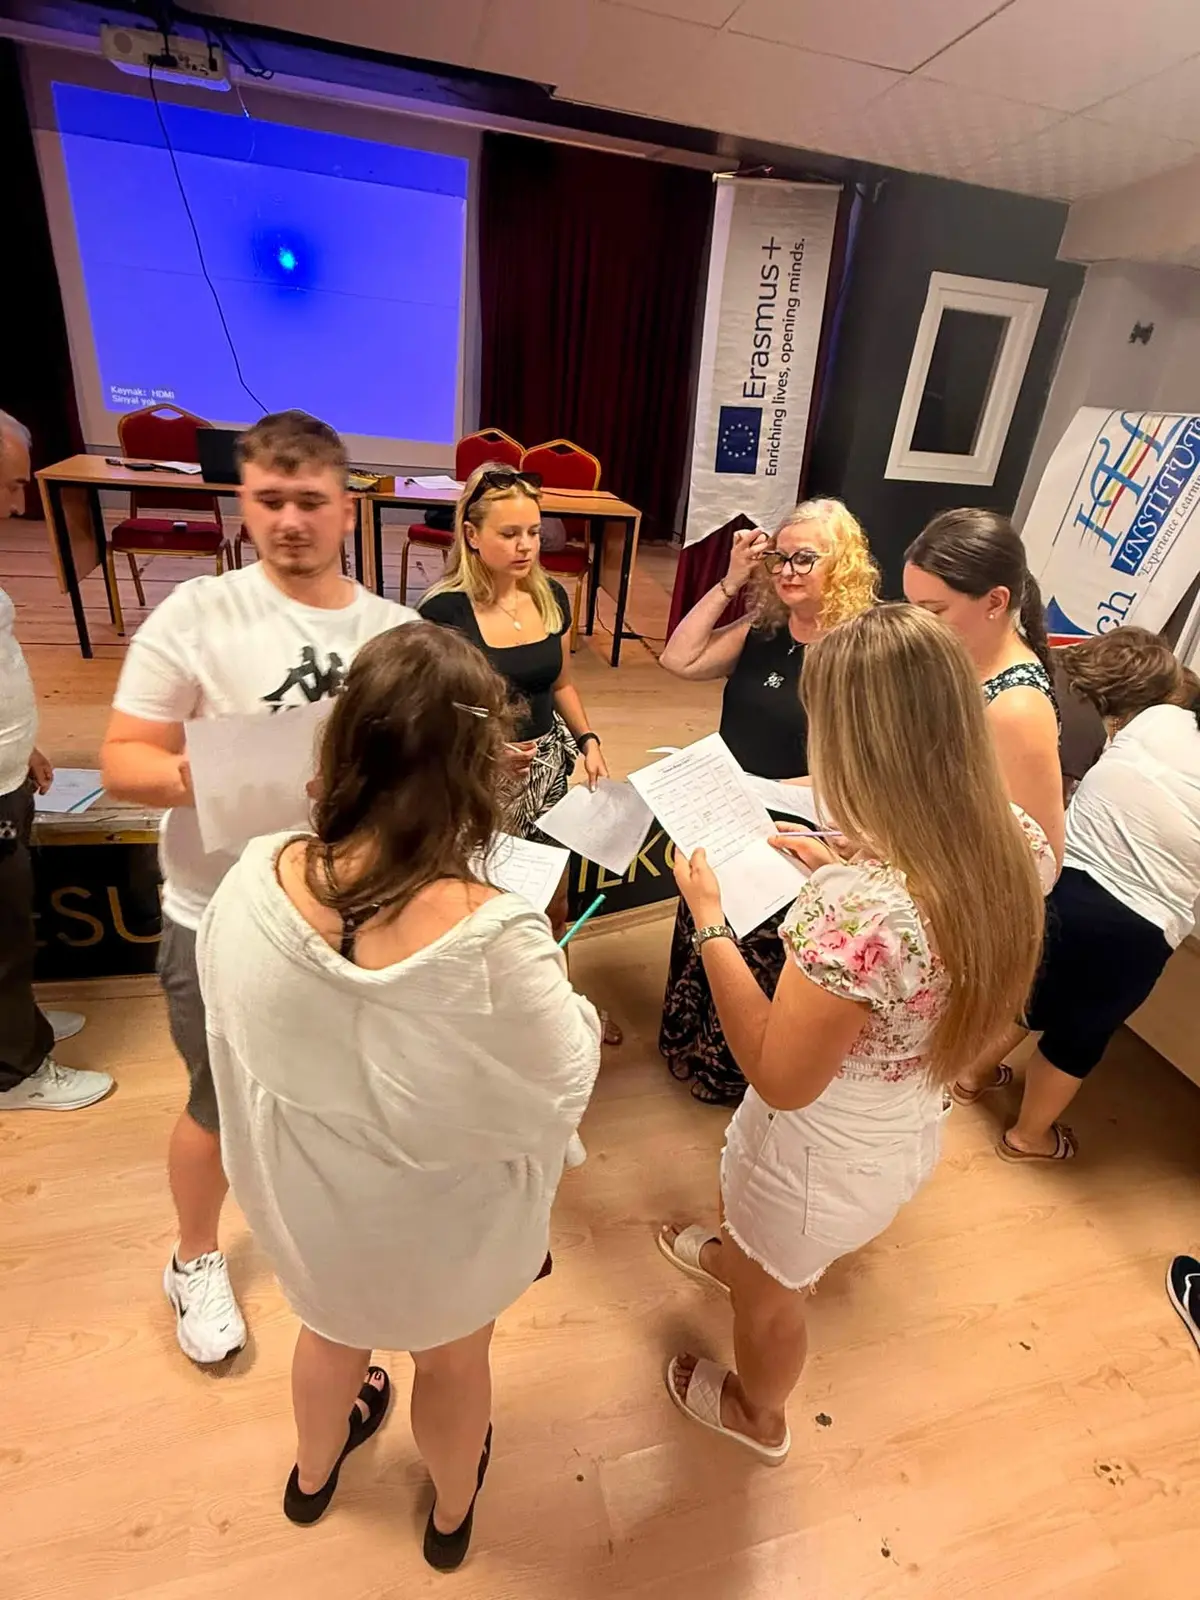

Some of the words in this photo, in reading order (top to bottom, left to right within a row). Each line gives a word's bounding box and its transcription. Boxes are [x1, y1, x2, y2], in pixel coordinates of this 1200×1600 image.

[788, 238, 805, 293] minds.
[743, 236, 782, 398] Erasmus+
[781, 298, 800, 363] opening
[151, 389, 175, 400] HDMI
[771, 367, 791, 404] lives,
[765, 408, 787, 476] Enriching
[31, 885, 163, 946] SU
